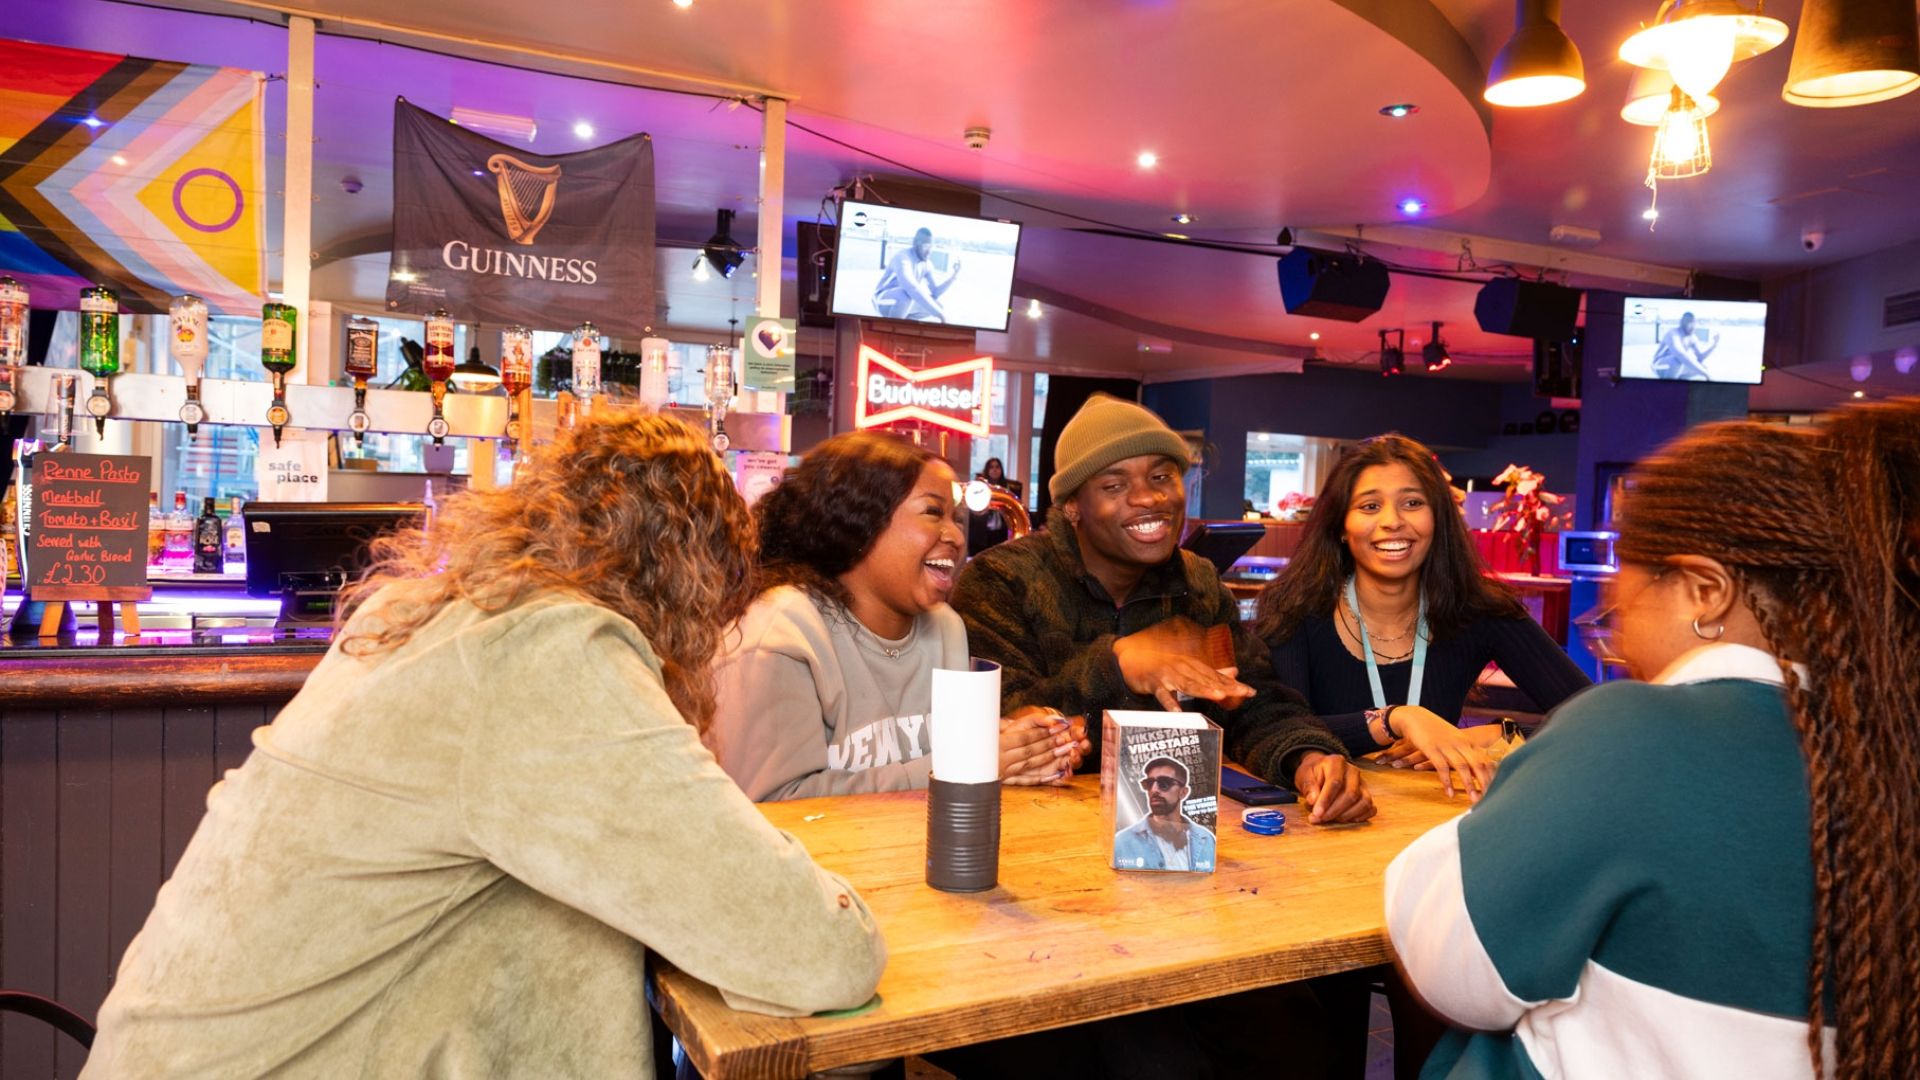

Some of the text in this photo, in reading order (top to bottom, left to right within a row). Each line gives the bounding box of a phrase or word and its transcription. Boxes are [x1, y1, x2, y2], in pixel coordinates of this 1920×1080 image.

[442, 240, 597, 284] GUINNESS
[868, 373, 980, 410] Budweiser
[43, 460, 140, 481] Penne Pasta
[269, 460, 301, 471] safe
[277, 472, 318, 484] place
[42, 489, 101, 504] Meatball
[40, 510, 87, 527] Tomato
[100, 510, 139, 528] Basil
[37, 533, 101, 548] Served with
[66, 549, 132, 562] Garlic Bread
[43, 562, 106, 584] £2.30
